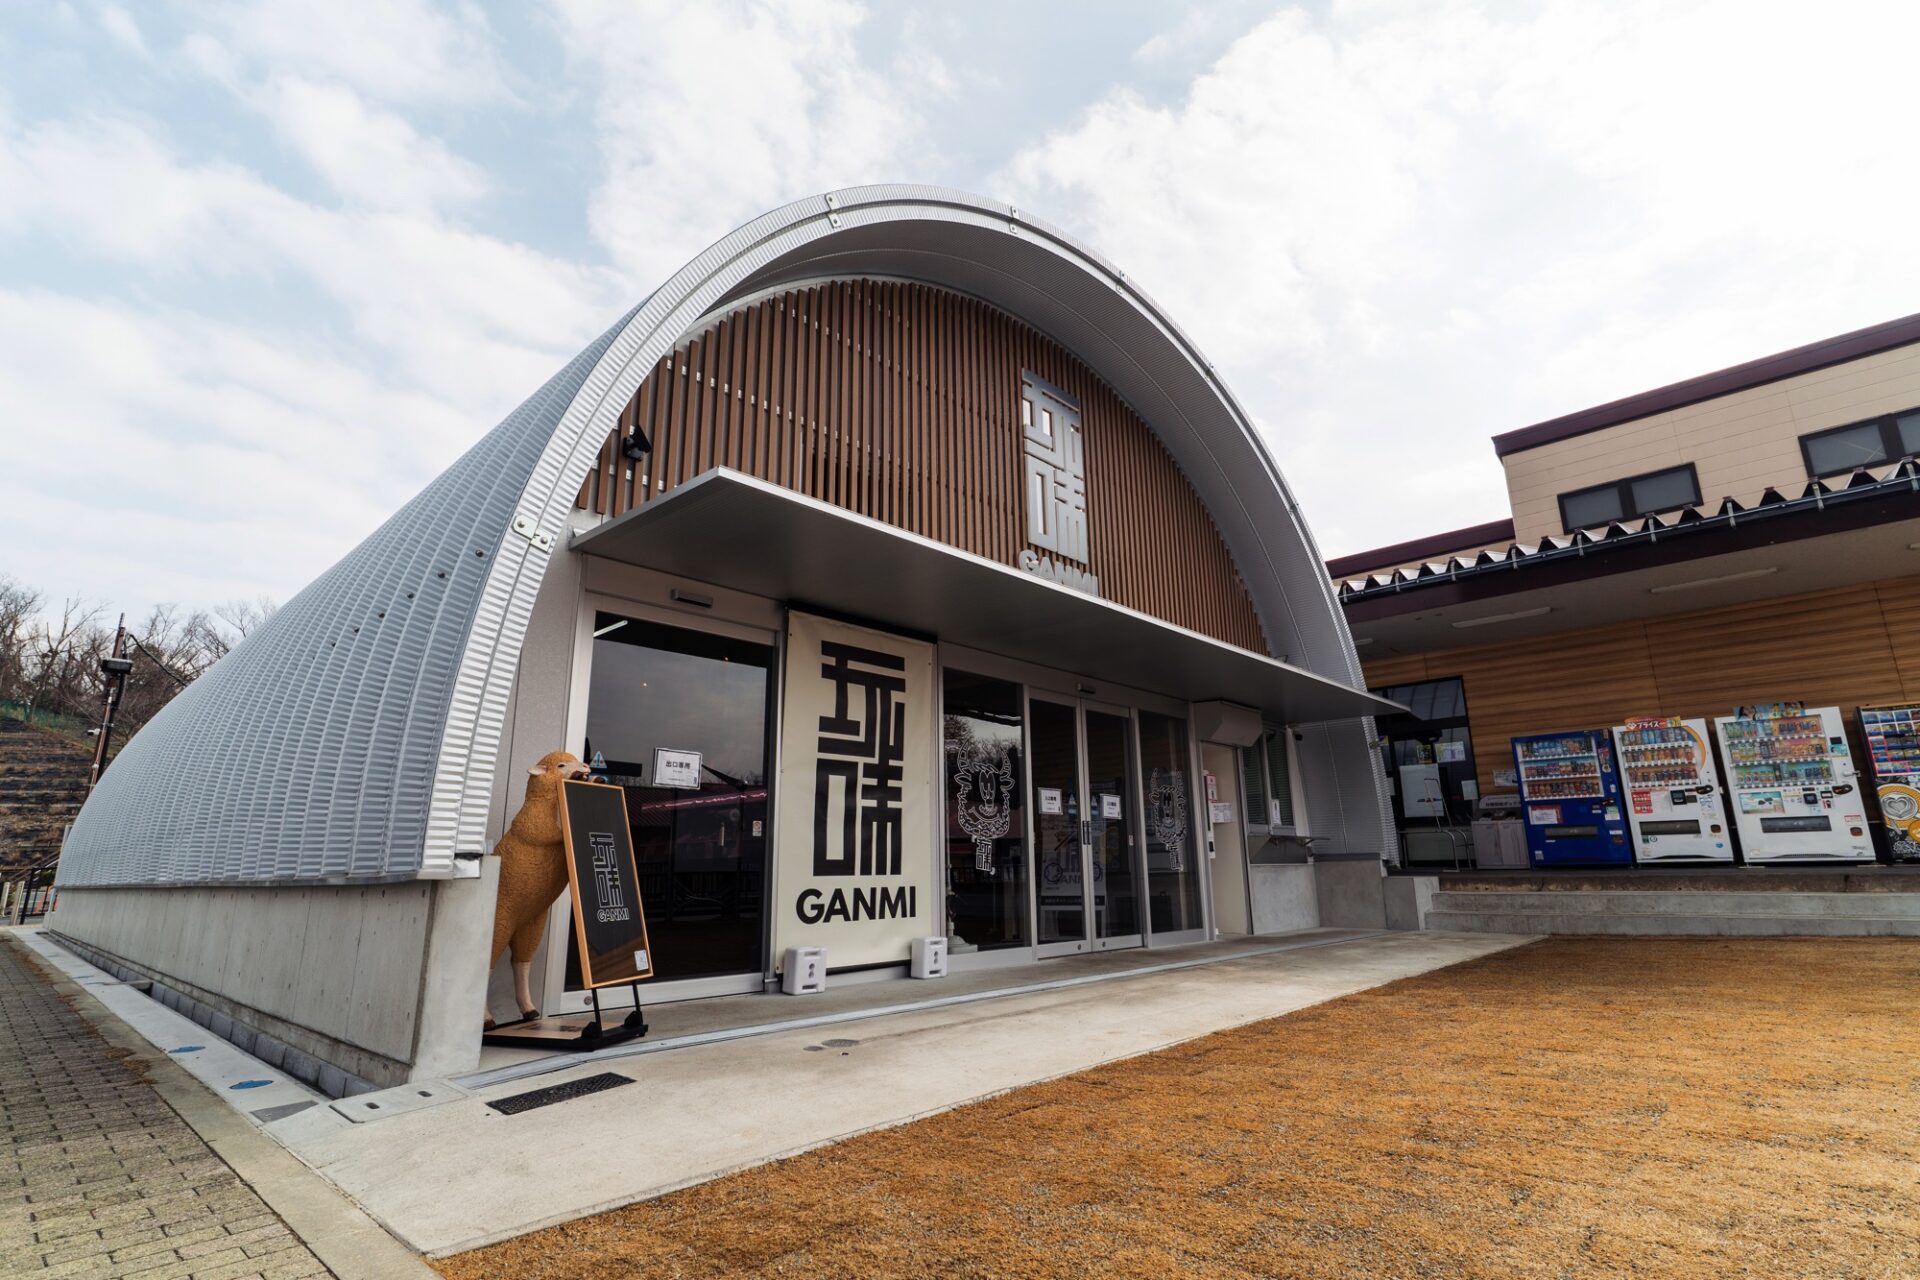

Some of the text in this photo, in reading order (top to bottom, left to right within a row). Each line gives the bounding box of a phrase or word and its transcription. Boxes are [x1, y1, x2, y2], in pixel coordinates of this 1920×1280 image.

[1018, 549, 1099, 597] GANMI
[597, 907, 630, 923] GANMI
[795, 885, 917, 925] GANMI
